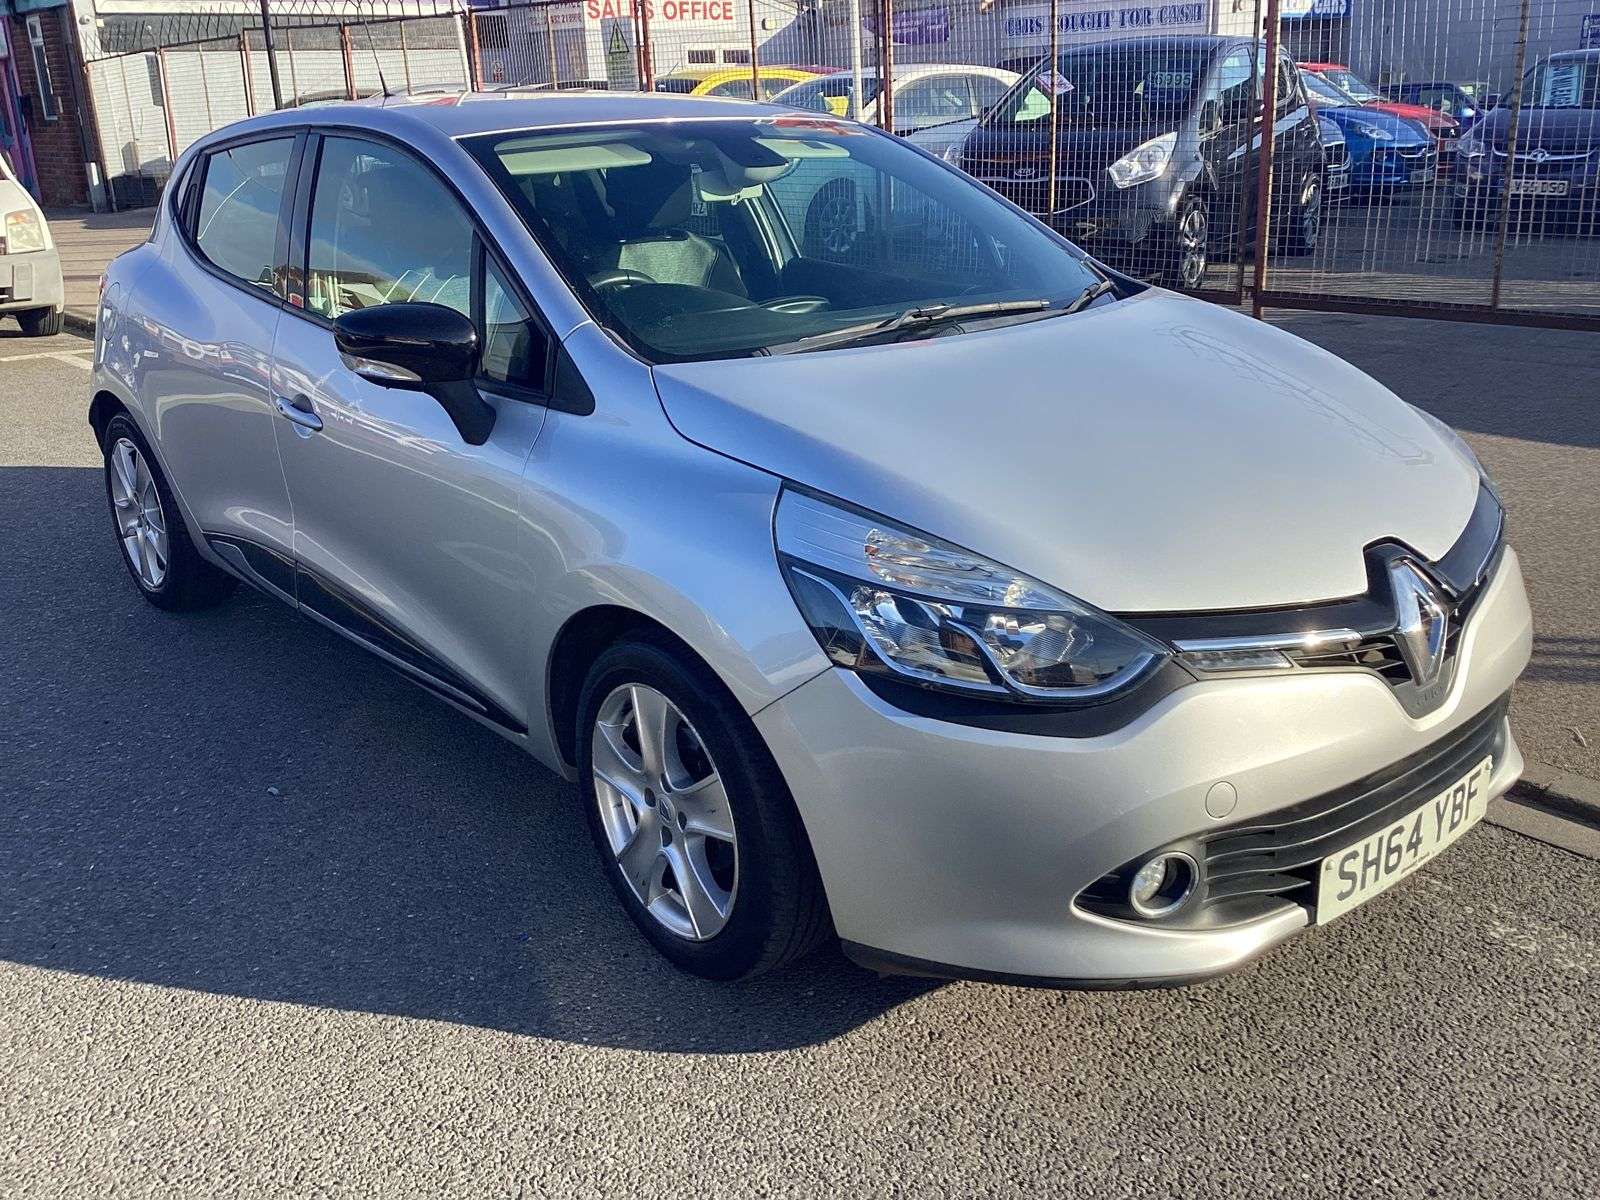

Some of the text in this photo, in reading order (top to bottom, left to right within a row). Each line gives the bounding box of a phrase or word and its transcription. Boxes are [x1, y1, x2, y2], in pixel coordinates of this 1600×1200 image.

[663, 1, 733, 20] OFFICE
[1005, 3, 1206, 36] CARS OUGHT FOR CASH
[1336, 768, 1482, 901] SH64 YBF
